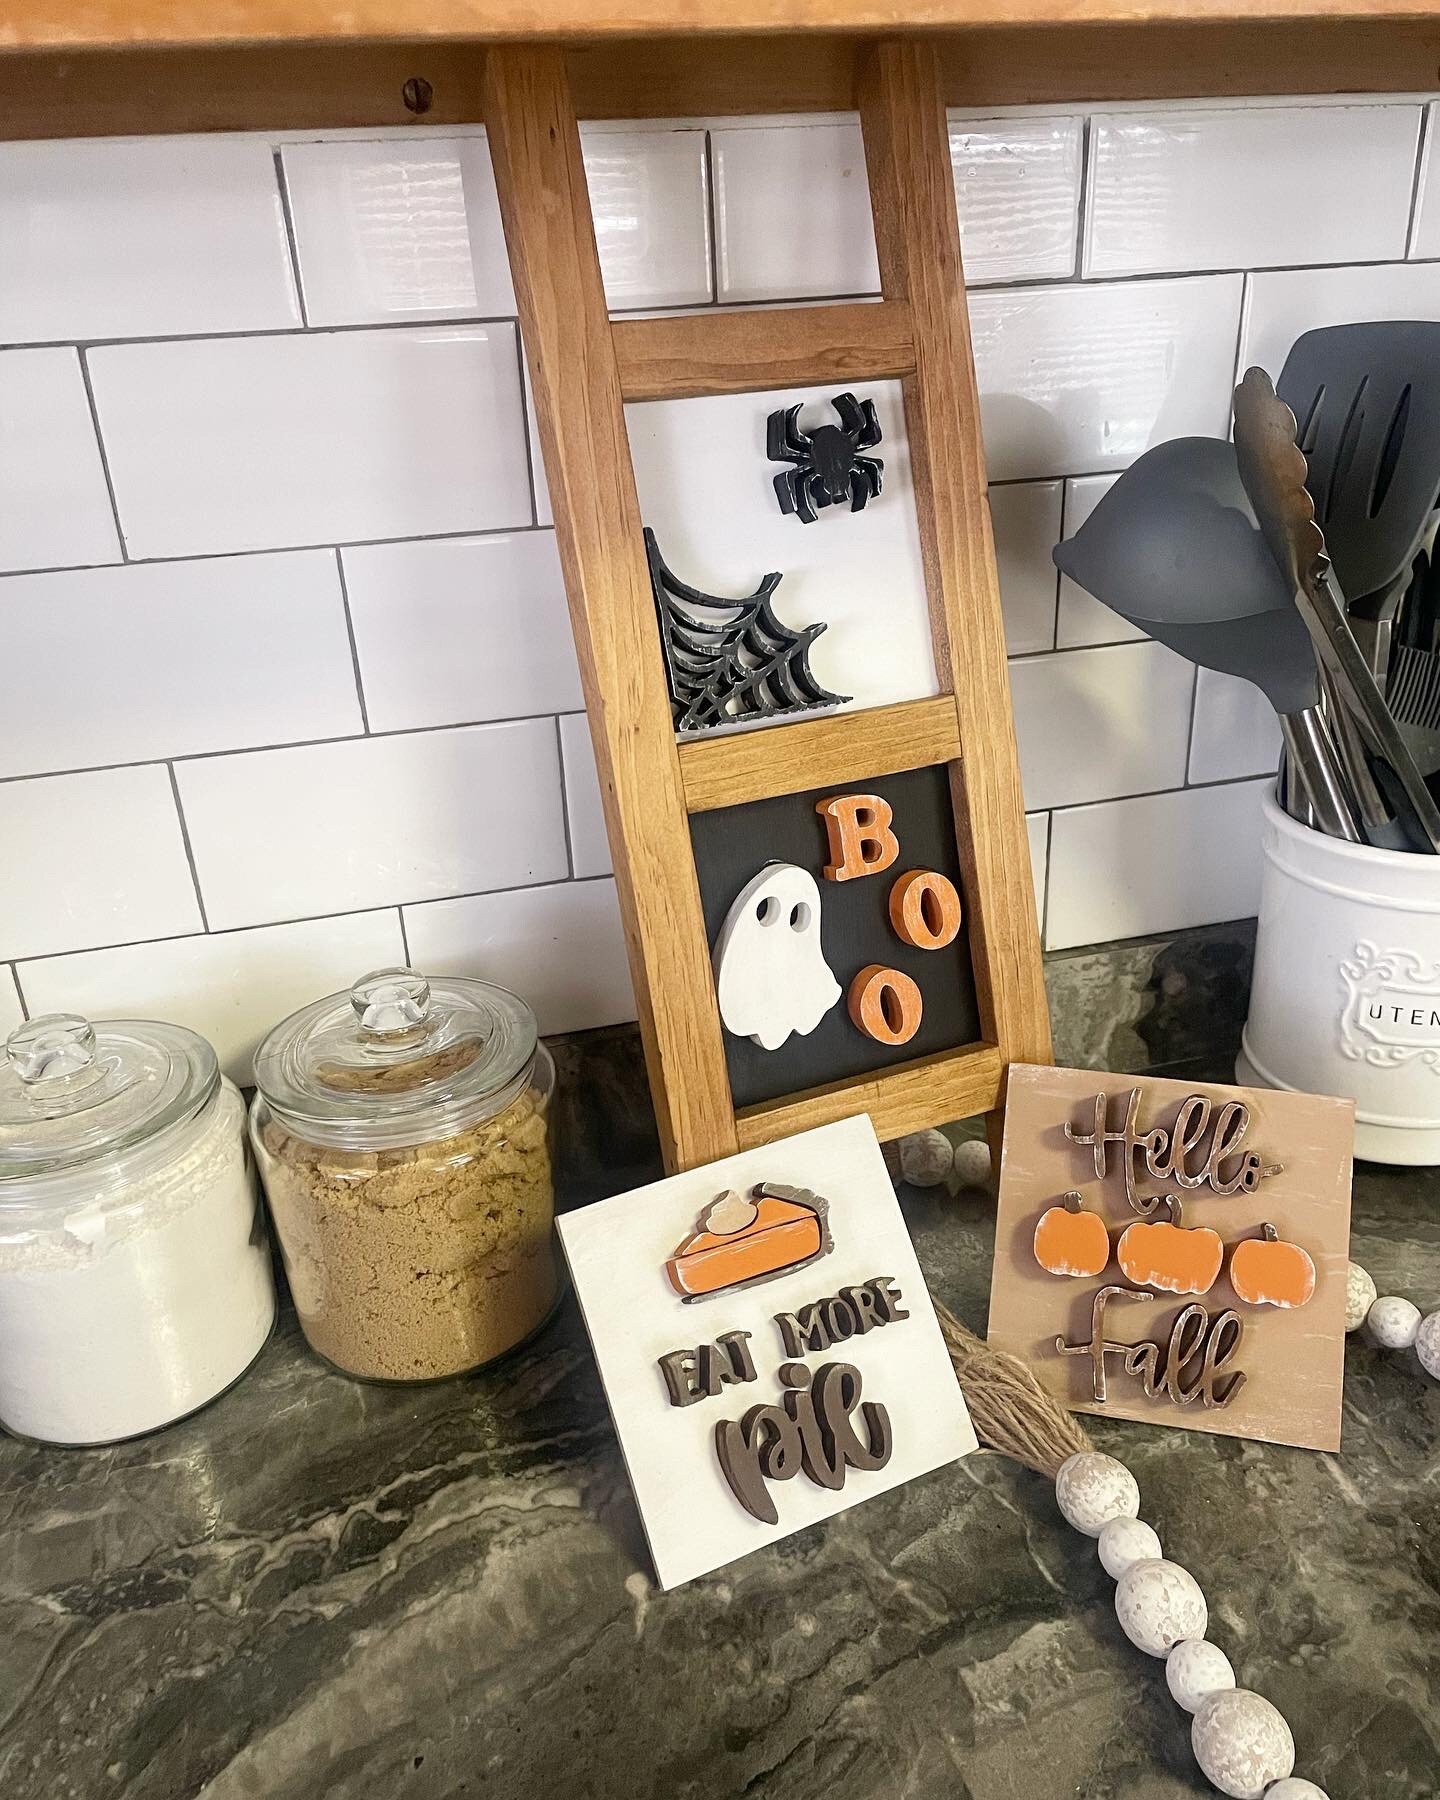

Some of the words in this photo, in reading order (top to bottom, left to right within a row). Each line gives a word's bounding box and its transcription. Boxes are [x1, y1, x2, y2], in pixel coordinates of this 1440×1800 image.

[1064, 1087, 1285, 1215] Hello
[658, 1330, 757, 1407] EAT
[773, 1276, 910, 1358] MORE
[714, 1362, 893, 1526] pie
